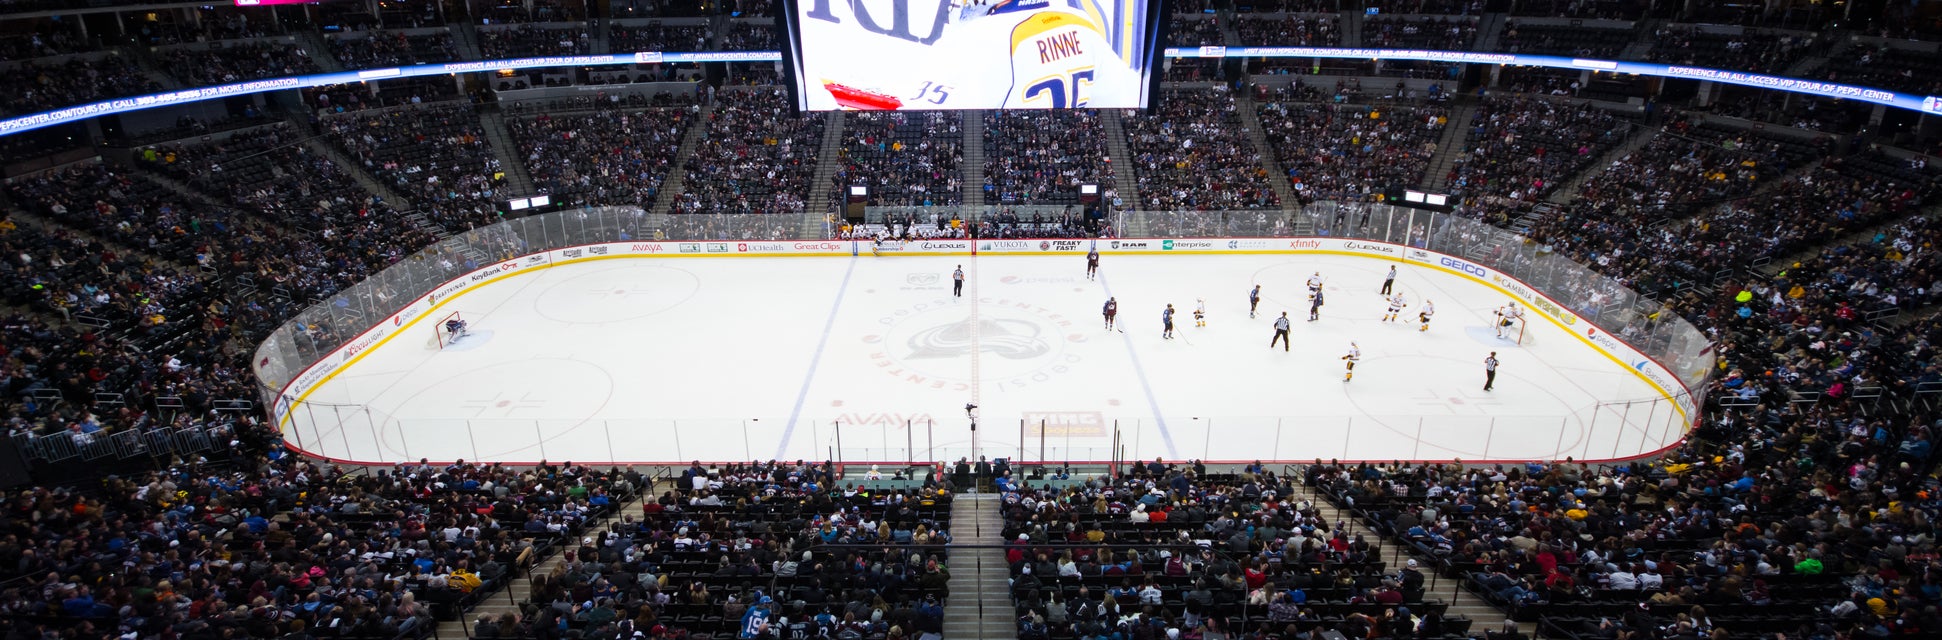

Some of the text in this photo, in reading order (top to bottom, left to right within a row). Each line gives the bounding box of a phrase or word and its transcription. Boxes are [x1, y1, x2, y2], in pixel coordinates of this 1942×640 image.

[1036, 30, 1082, 64] RINNE
[445, 62, 484, 71] EXPERIENCE
[546, 57, 563, 65] TOUR
[1443, 52, 1463, 60] MORE
[1464, 53, 1515, 62] INFORMATION
[1668, 66, 1717, 79] EXPERIENCE
[1718, 72, 1730, 80] AN
[1780, 78, 1794, 87] VIP
[1796, 80, 1821, 91] TOUR
[1822, 84, 1836, 93] OF
[1836, 86, 1862, 97] PEPSI
[1863, 89, 1894, 102] CENTER
[98, 102, 112, 111] OR
[114, 98, 136, 109] CALL
[202, 87, 218, 97] FOR
[219, 84, 243, 96] MORE
[244, 78, 299, 91] INFORMATION
[910, 81, 954, 104] 35
[632, 244, 664, 254] AVAYA
[748, 244, 784, 252] UCHealth
[794, 242, 840, 252] Great Clips
[1290, 240, 1320, 249] xfinity
[1357, 243, 1393, 253] LEXUS
[472, 267, 501, 282] KeyBank
[1440, 256, 1486, 278] GEICO
[435, 282, 466, 300] DRAFTKINGS
[1501, 278, 1532, 301] CAMBRIA
[368, 329, 384, 344] LIGHT
[830, 412, 938, 429] AVAYA
[746, 616, 763, 634] 19
